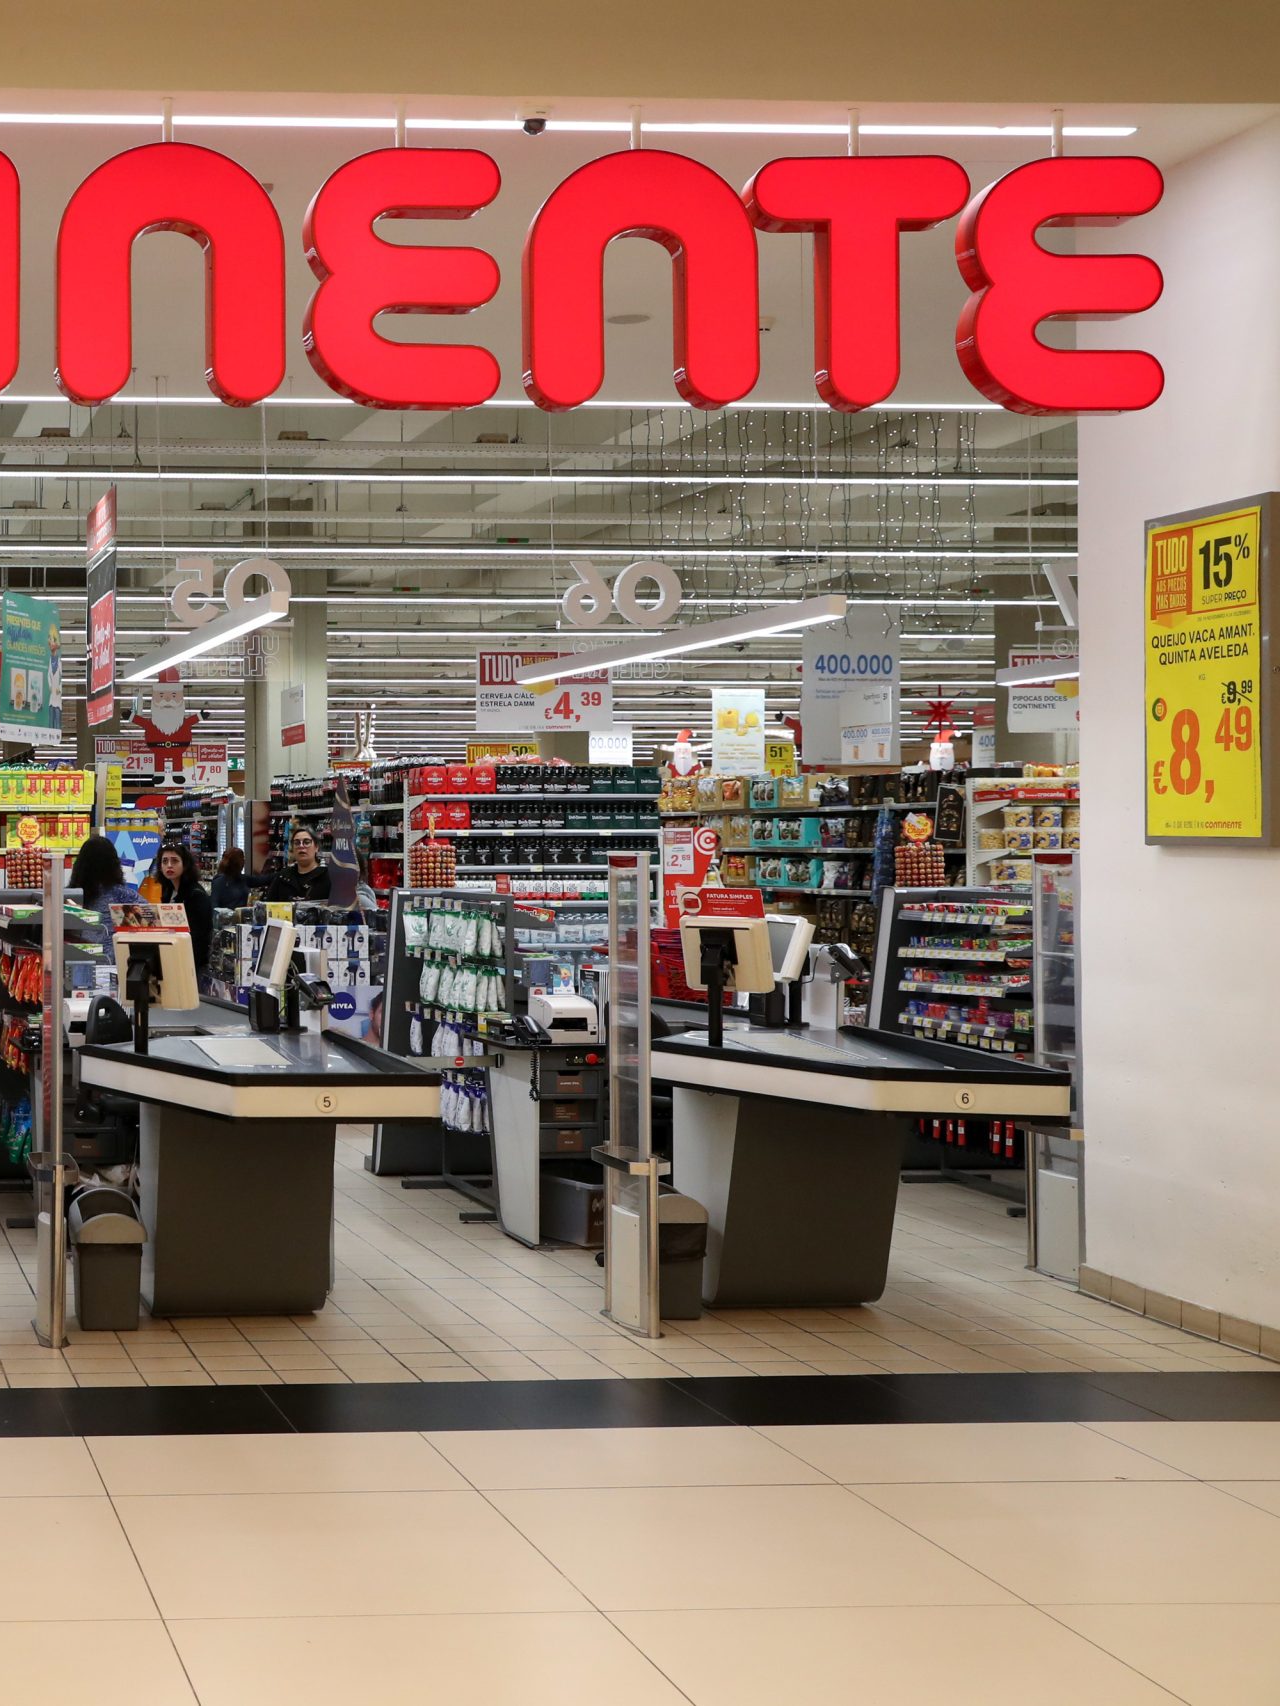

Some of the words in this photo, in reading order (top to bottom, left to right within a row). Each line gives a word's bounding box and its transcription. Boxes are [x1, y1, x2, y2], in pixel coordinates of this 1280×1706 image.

[1156, 535, 1188, 576] TUDO
[1199, 533, 1250, 590] 15%
[1201, 594, 1223, 605] SUPER
[1224, 590, 1247, 603] PREÇO
[1152, 632, 1187, 649] QUEIJO
[1189, 628, 1216, 644] VACA
[1218, 623, 1255, 640] AMANT.
[1159, 649, 1196, 666] QUINTA
[1199, 643, 1249, 661] AVELEDA
[482, 655, 523, 684] TUDO
[815, 654, 893, 675] 400.000
[97, 740, 115, 753] TUDO
[20, 822, 38, 830] Chupa
[1205, 821, 1242, 829] CONTINENTE
[19, 829, 37, 837] Chups
[132, 835, 158, 846] AQUARIUS
[335, 838, 349, 850] NIVEA
[323, 1096, 331, 1108] 5
[961, 1092, 970, 1105] 6
